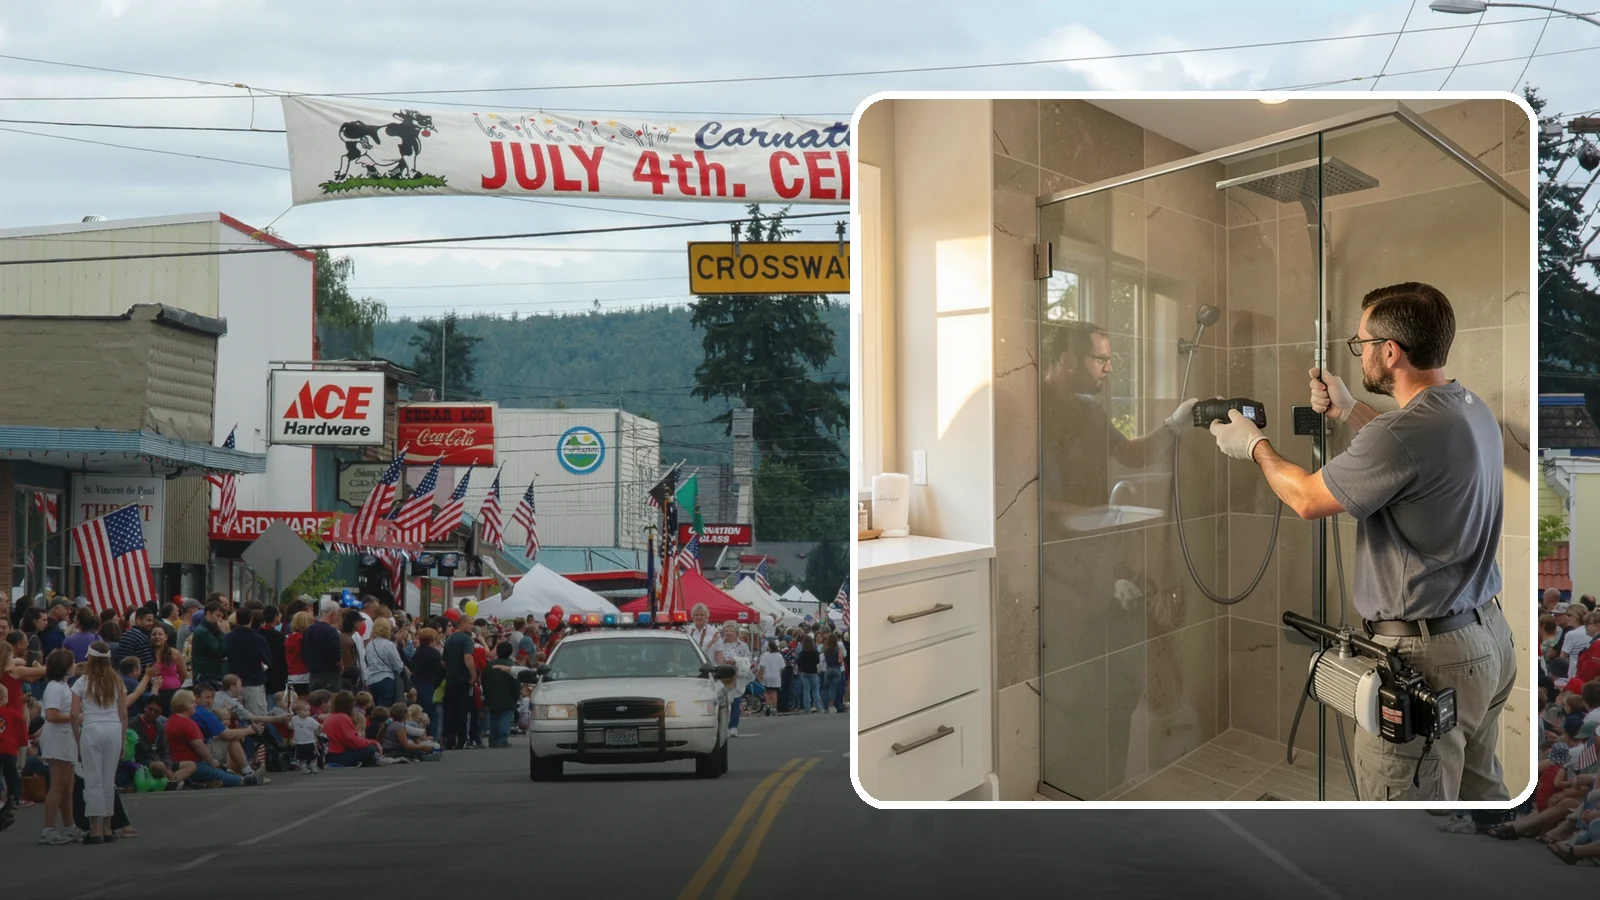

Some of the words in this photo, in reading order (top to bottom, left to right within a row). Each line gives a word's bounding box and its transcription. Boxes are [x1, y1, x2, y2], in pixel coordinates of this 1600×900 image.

[694, 121, 850, 150] Carnat
[481, 141, 604, 192] JULY
[632, 150, 746, 197] 4th.
[697, 254, 850, 280] CROSSWA
[283, 380, 373, 420] ACE
[406, 409, 452, 422] CEDAR
[461, 409, 485, 422] LOG
[283, 421, 370, 436] Hardware
[416, 428, 477, 447] Coca-Cola
[353, 467, 385, 479] Simpl
[96, 485, 124, 495] Vincent
[127, 485, 135, 495] de
[138, 485, 155, 495] Paul
[212, 516, 330, 535] HARDARE
[688, 527, 741, 535] CRNATION
[699, 535, 730, 543] GLASS
